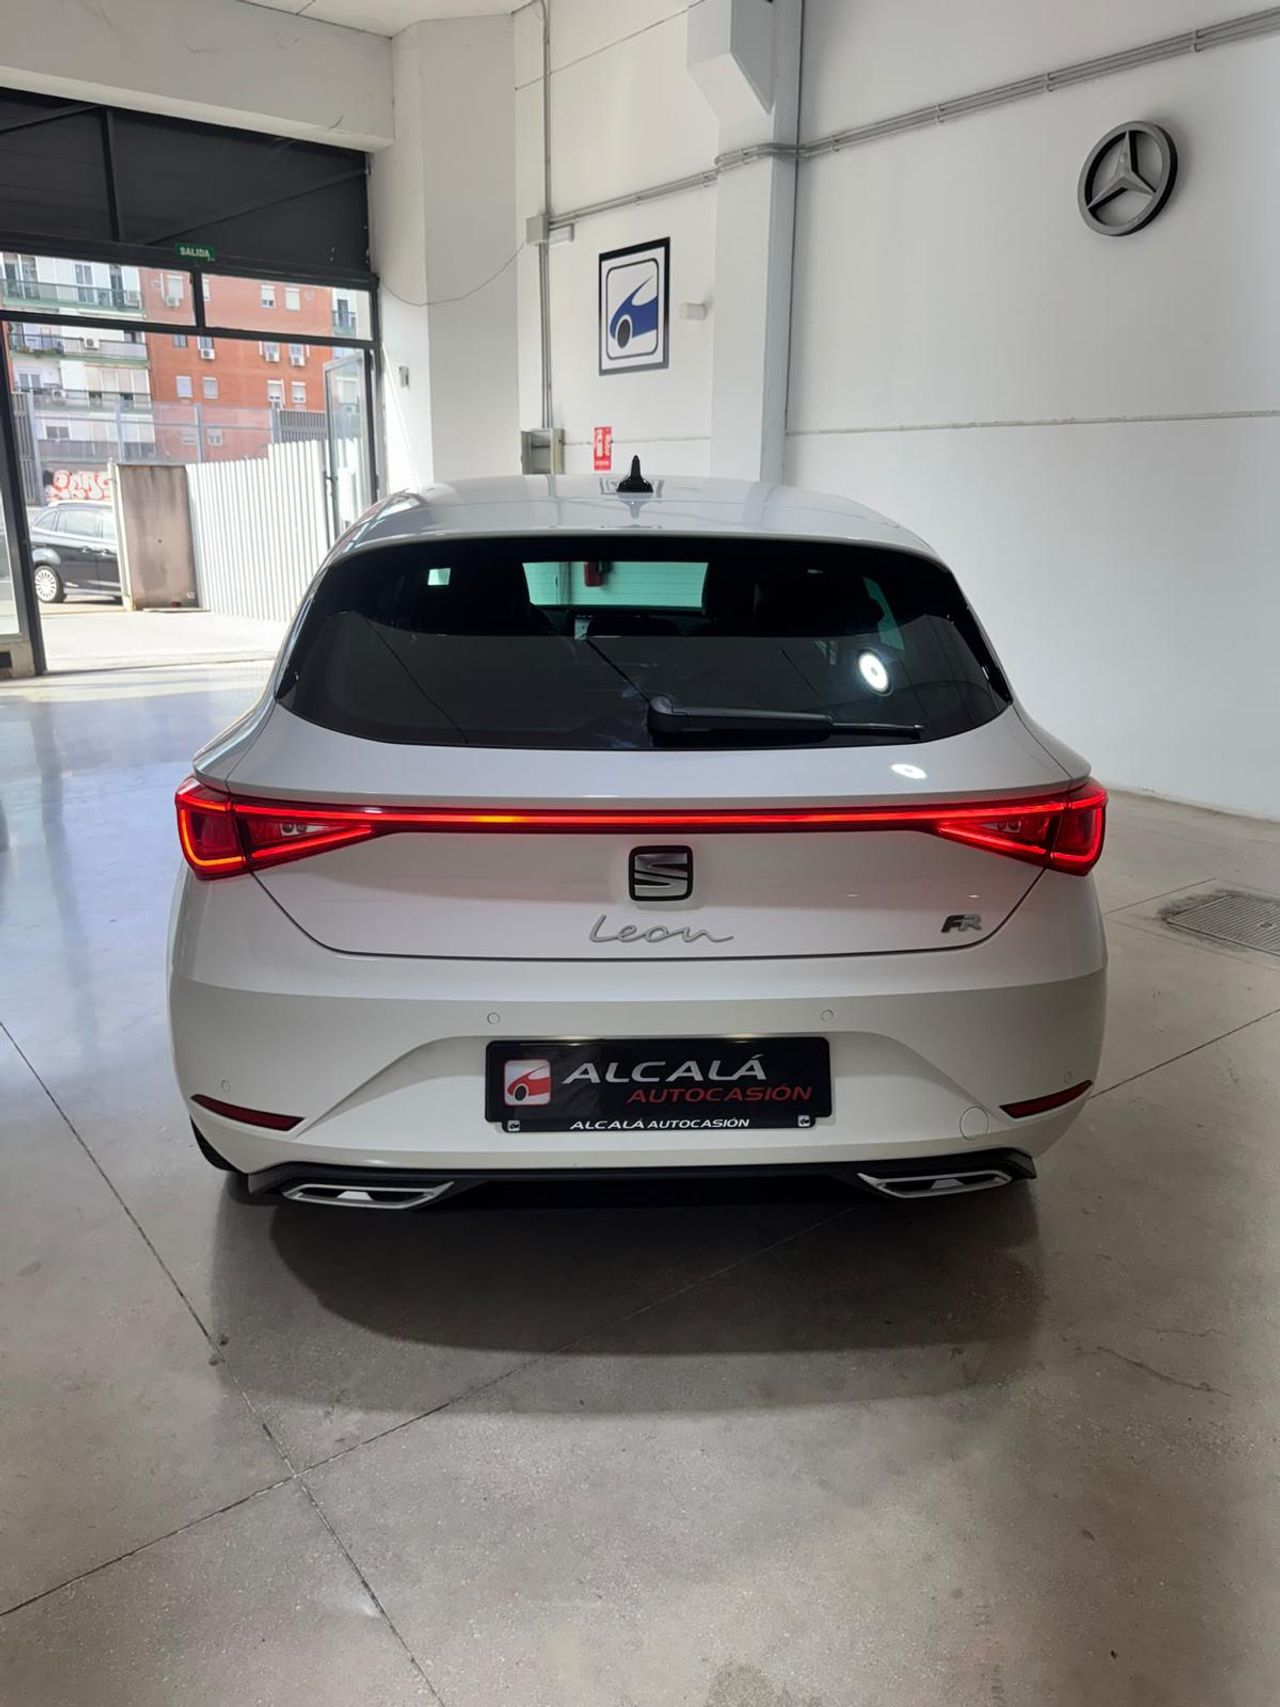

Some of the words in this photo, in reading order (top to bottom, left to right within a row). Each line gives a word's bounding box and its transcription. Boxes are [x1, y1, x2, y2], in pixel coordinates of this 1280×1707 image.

[179, 246, 210, 257] SALIDA
[588, 914, 734, 944] Leon
[941, 913, 982, 933] FR
[562, 1053, 767, 1084] ALCALÁ
[626, 1083, 813, 1103] AUTOCASIÓN
[569, 1117, 645, 1130] ALCALÁ
[647, 1116, 751, 1129] AUTOCASIÓN
